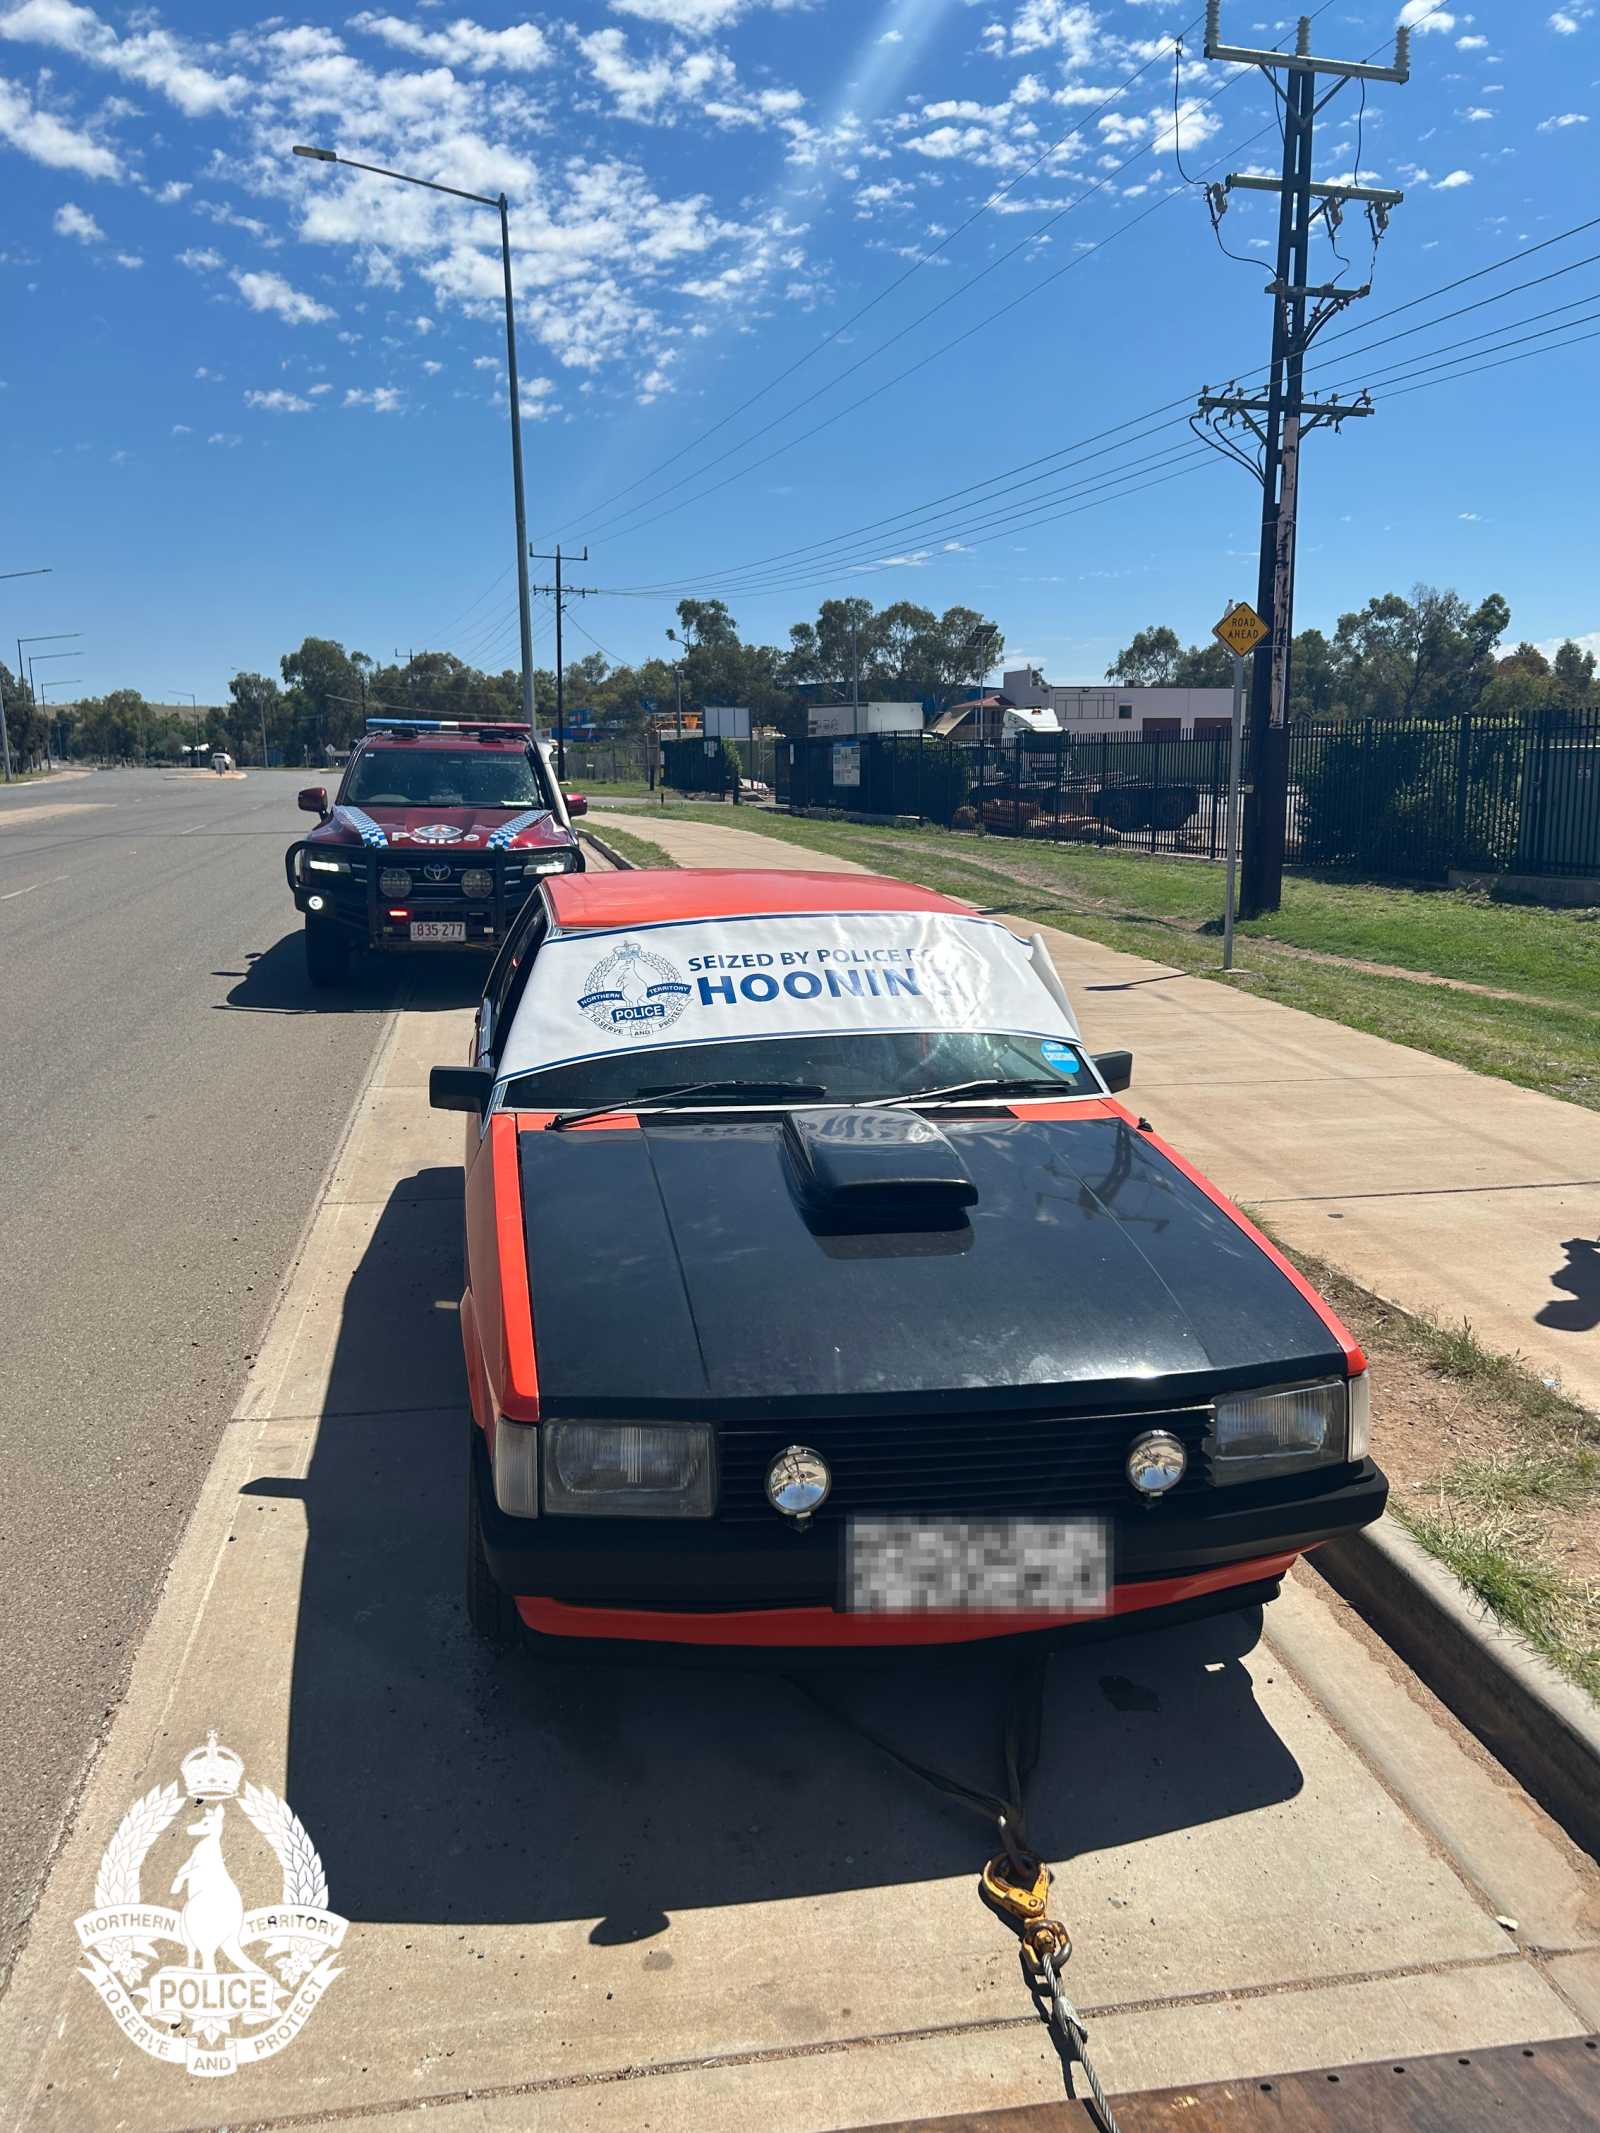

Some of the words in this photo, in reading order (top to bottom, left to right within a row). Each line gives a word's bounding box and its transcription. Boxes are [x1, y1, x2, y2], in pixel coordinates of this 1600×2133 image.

[1232, 618, 1256, 627] ROAD
[1228, 630, 1259, 639] AHEAD
[688, 953, 774, 972] SEIZED
[780, 951, 810, 965] BY
[817, 949, 901, 963] POLICE
[581, 992, 621, 1006] NORTHERN
[648, 985, 688, 995] TERRITORY
[590, 1013, 598, 1023] TO
[598, 1021, 624, 1034] SERVE
[658, 1003, 685, 1029] PROTECT
[615, 1006, 662, 1021] POLICE
